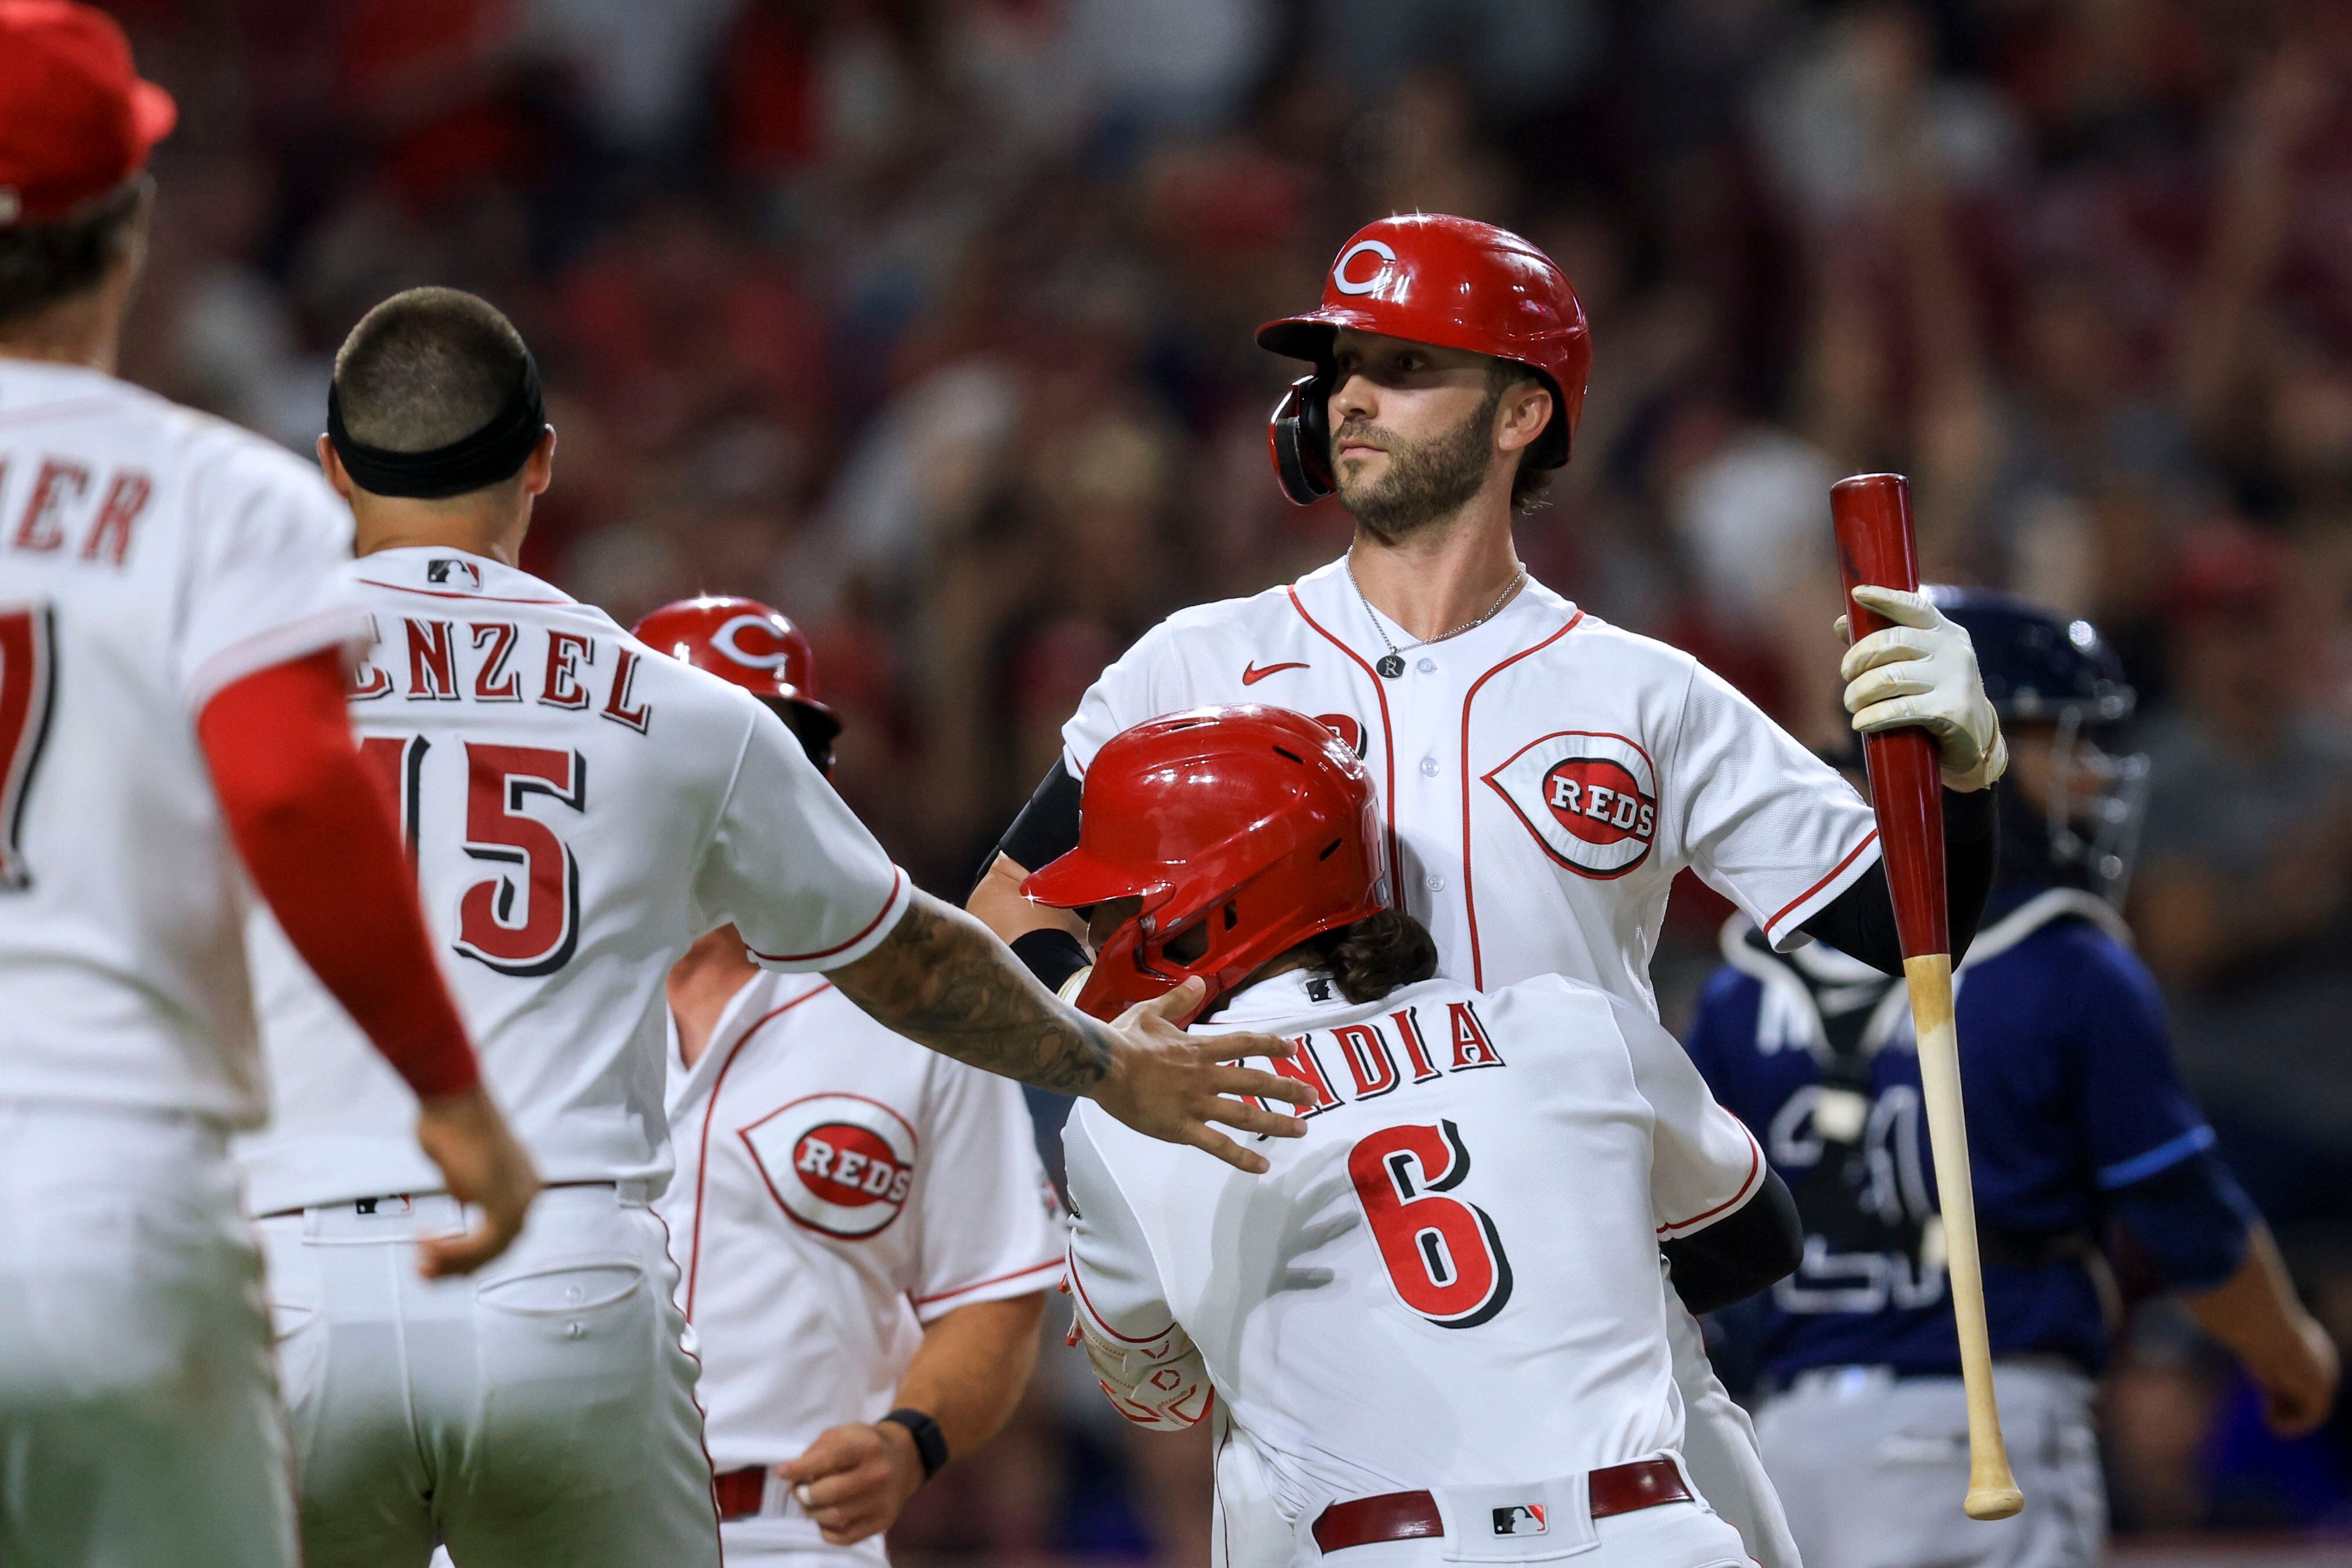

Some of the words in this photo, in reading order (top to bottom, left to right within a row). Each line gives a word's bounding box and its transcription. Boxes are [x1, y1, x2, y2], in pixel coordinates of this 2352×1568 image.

[1333, 240, 1397, 296] C
[0, 454, 152, 566] ER
[709, 614, 789, 670] C
[1551, 774, 1655, 839] REDS
[797, 1135, 913, 1204] REDS
[1344, 1119, 1513, 1329] 6
